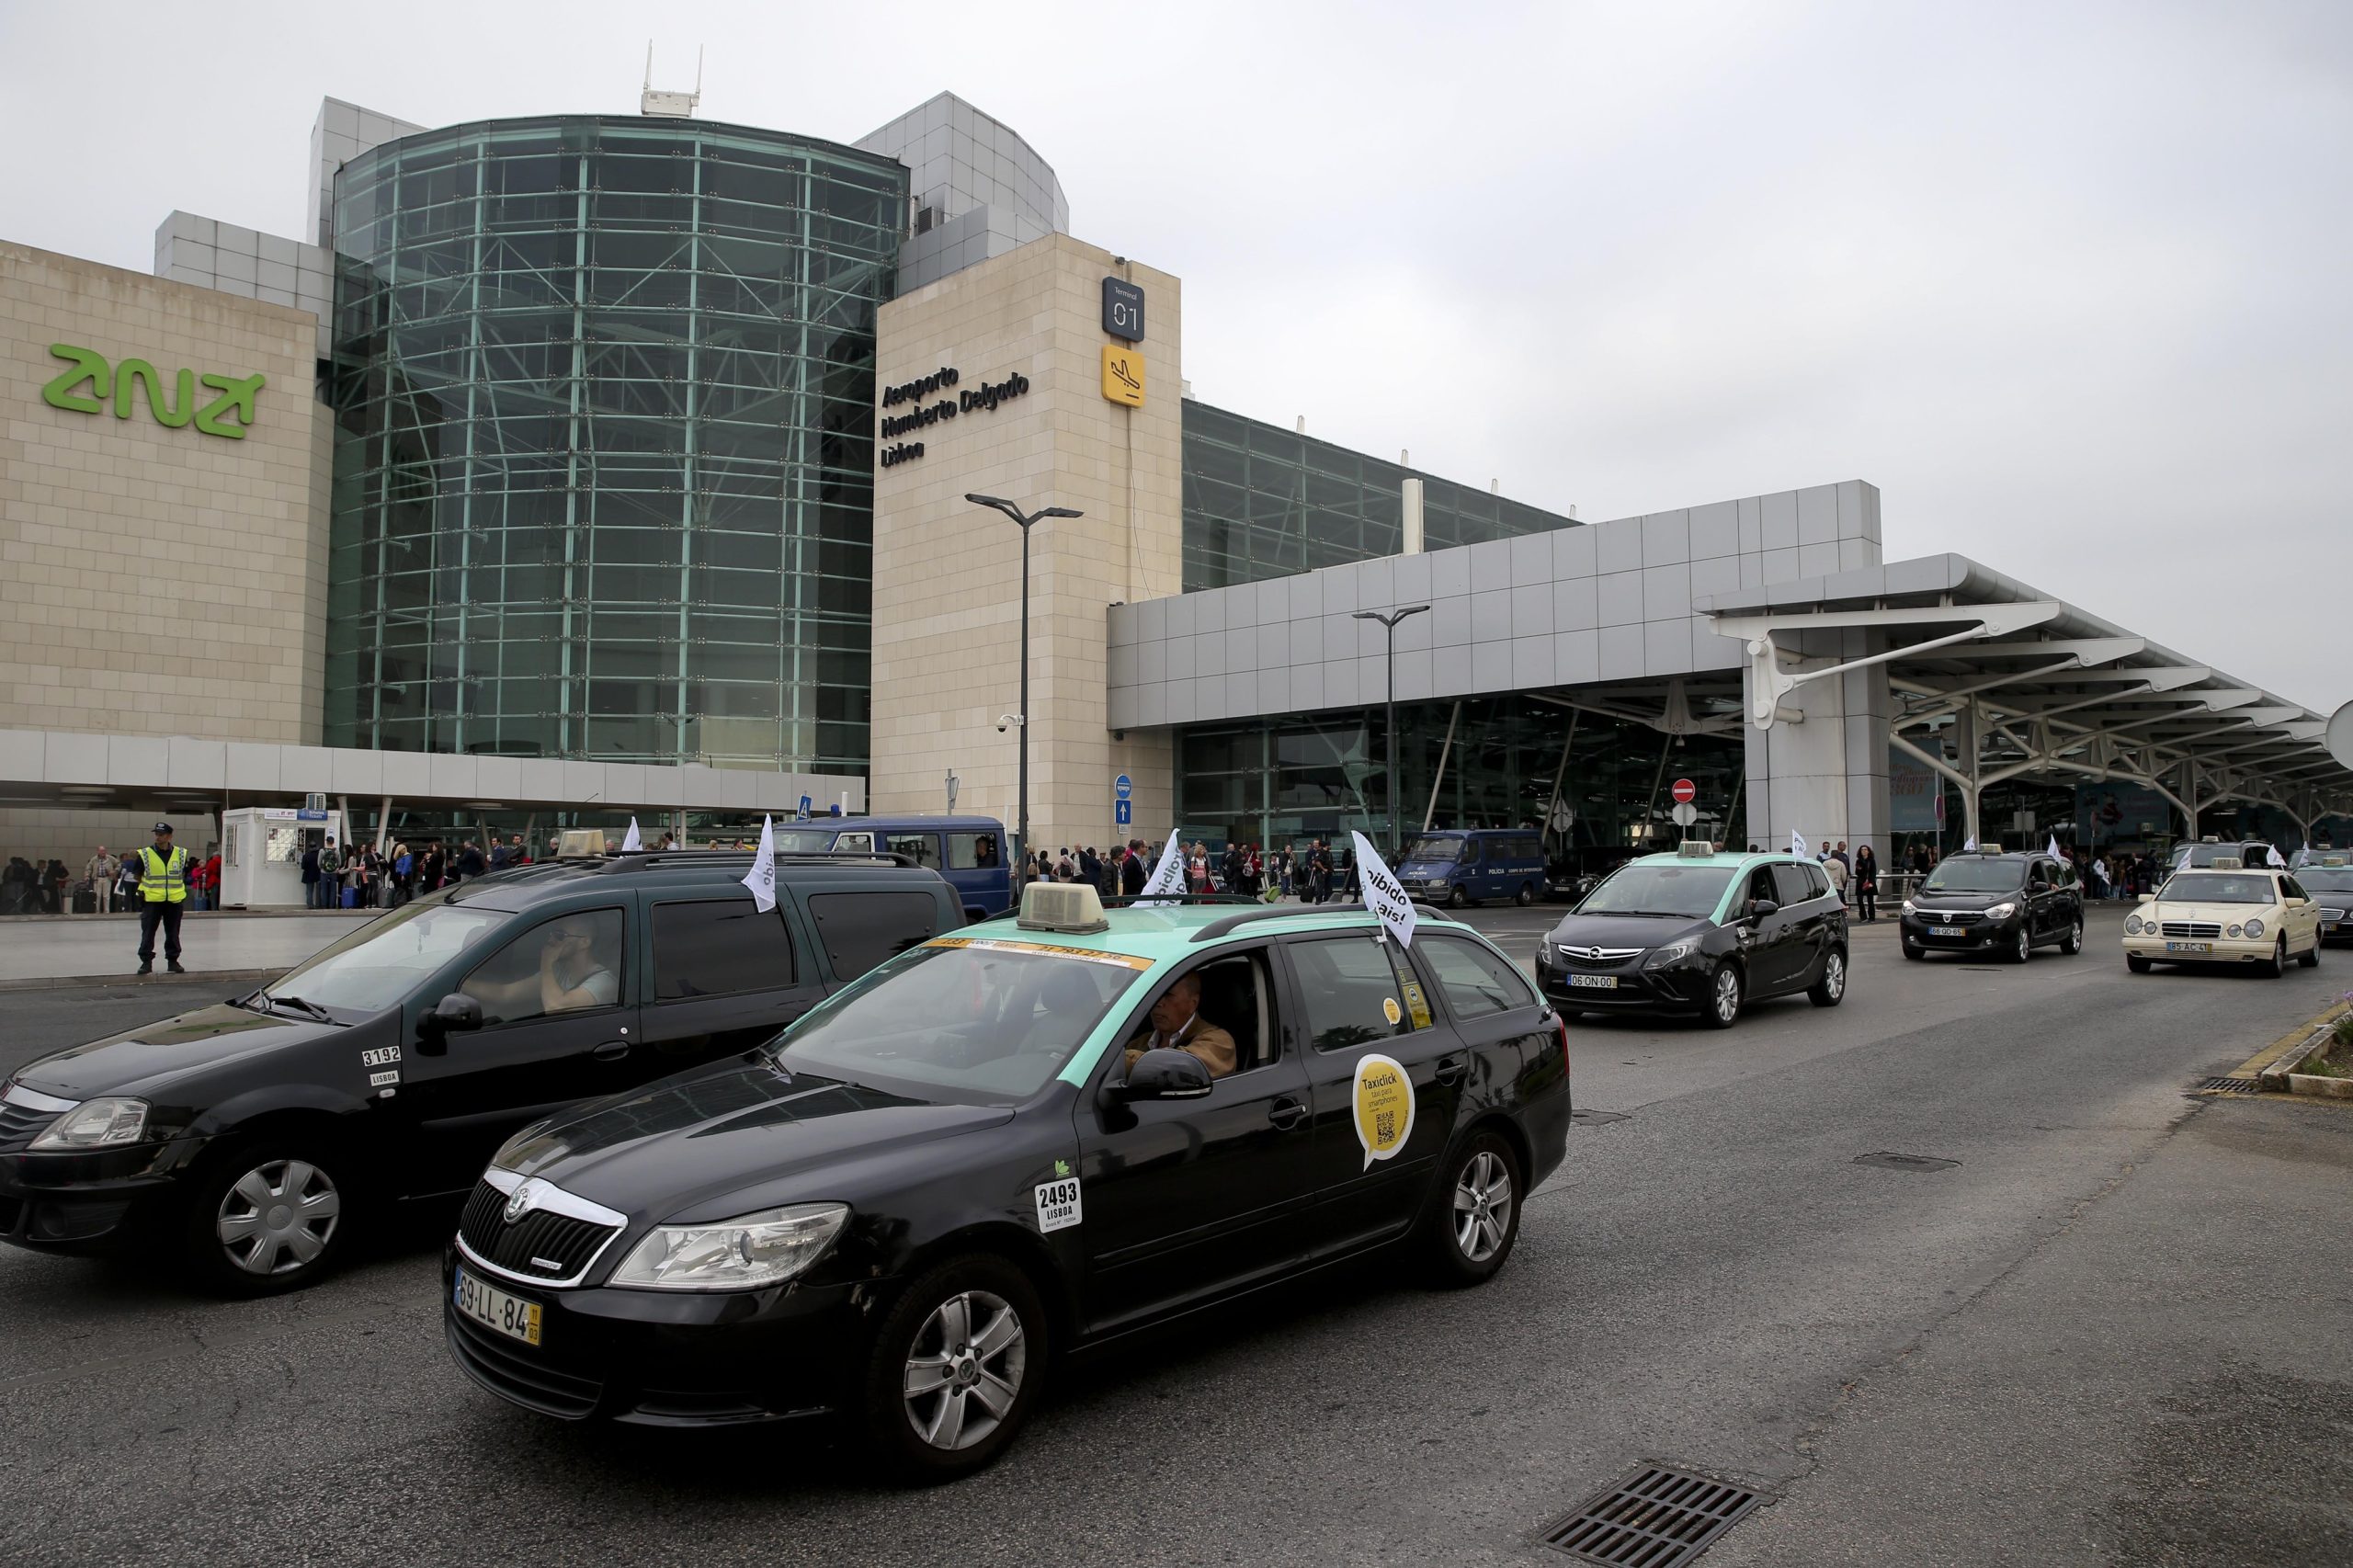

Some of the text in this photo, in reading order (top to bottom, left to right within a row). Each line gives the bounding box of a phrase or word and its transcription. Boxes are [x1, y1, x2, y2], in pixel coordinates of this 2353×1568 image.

[1114, 286, 1137, 301] Terminal
[1113, 302, 1137, 331] 01
[881, 367, 959, 408] Aeroporto
[881, 372, 1029, 439] Humberto Delgado
[881, 442, 925, 468] Lisboa
[1377, 901, 1406, 926] ais!
[364, 1047, 400, 1065] 3192
[372, 1074, 396, 1084] LISBOA
[1361, 1072, 1398, 1091] Taxiclick
[1381, 1087, 1392, 1096] para
[1368, 1095, 1398, 1108] smartphones
[1039, 1182, 1077, 1209] 2493
[1046, 1205, 1073, 1220] LISBOA
